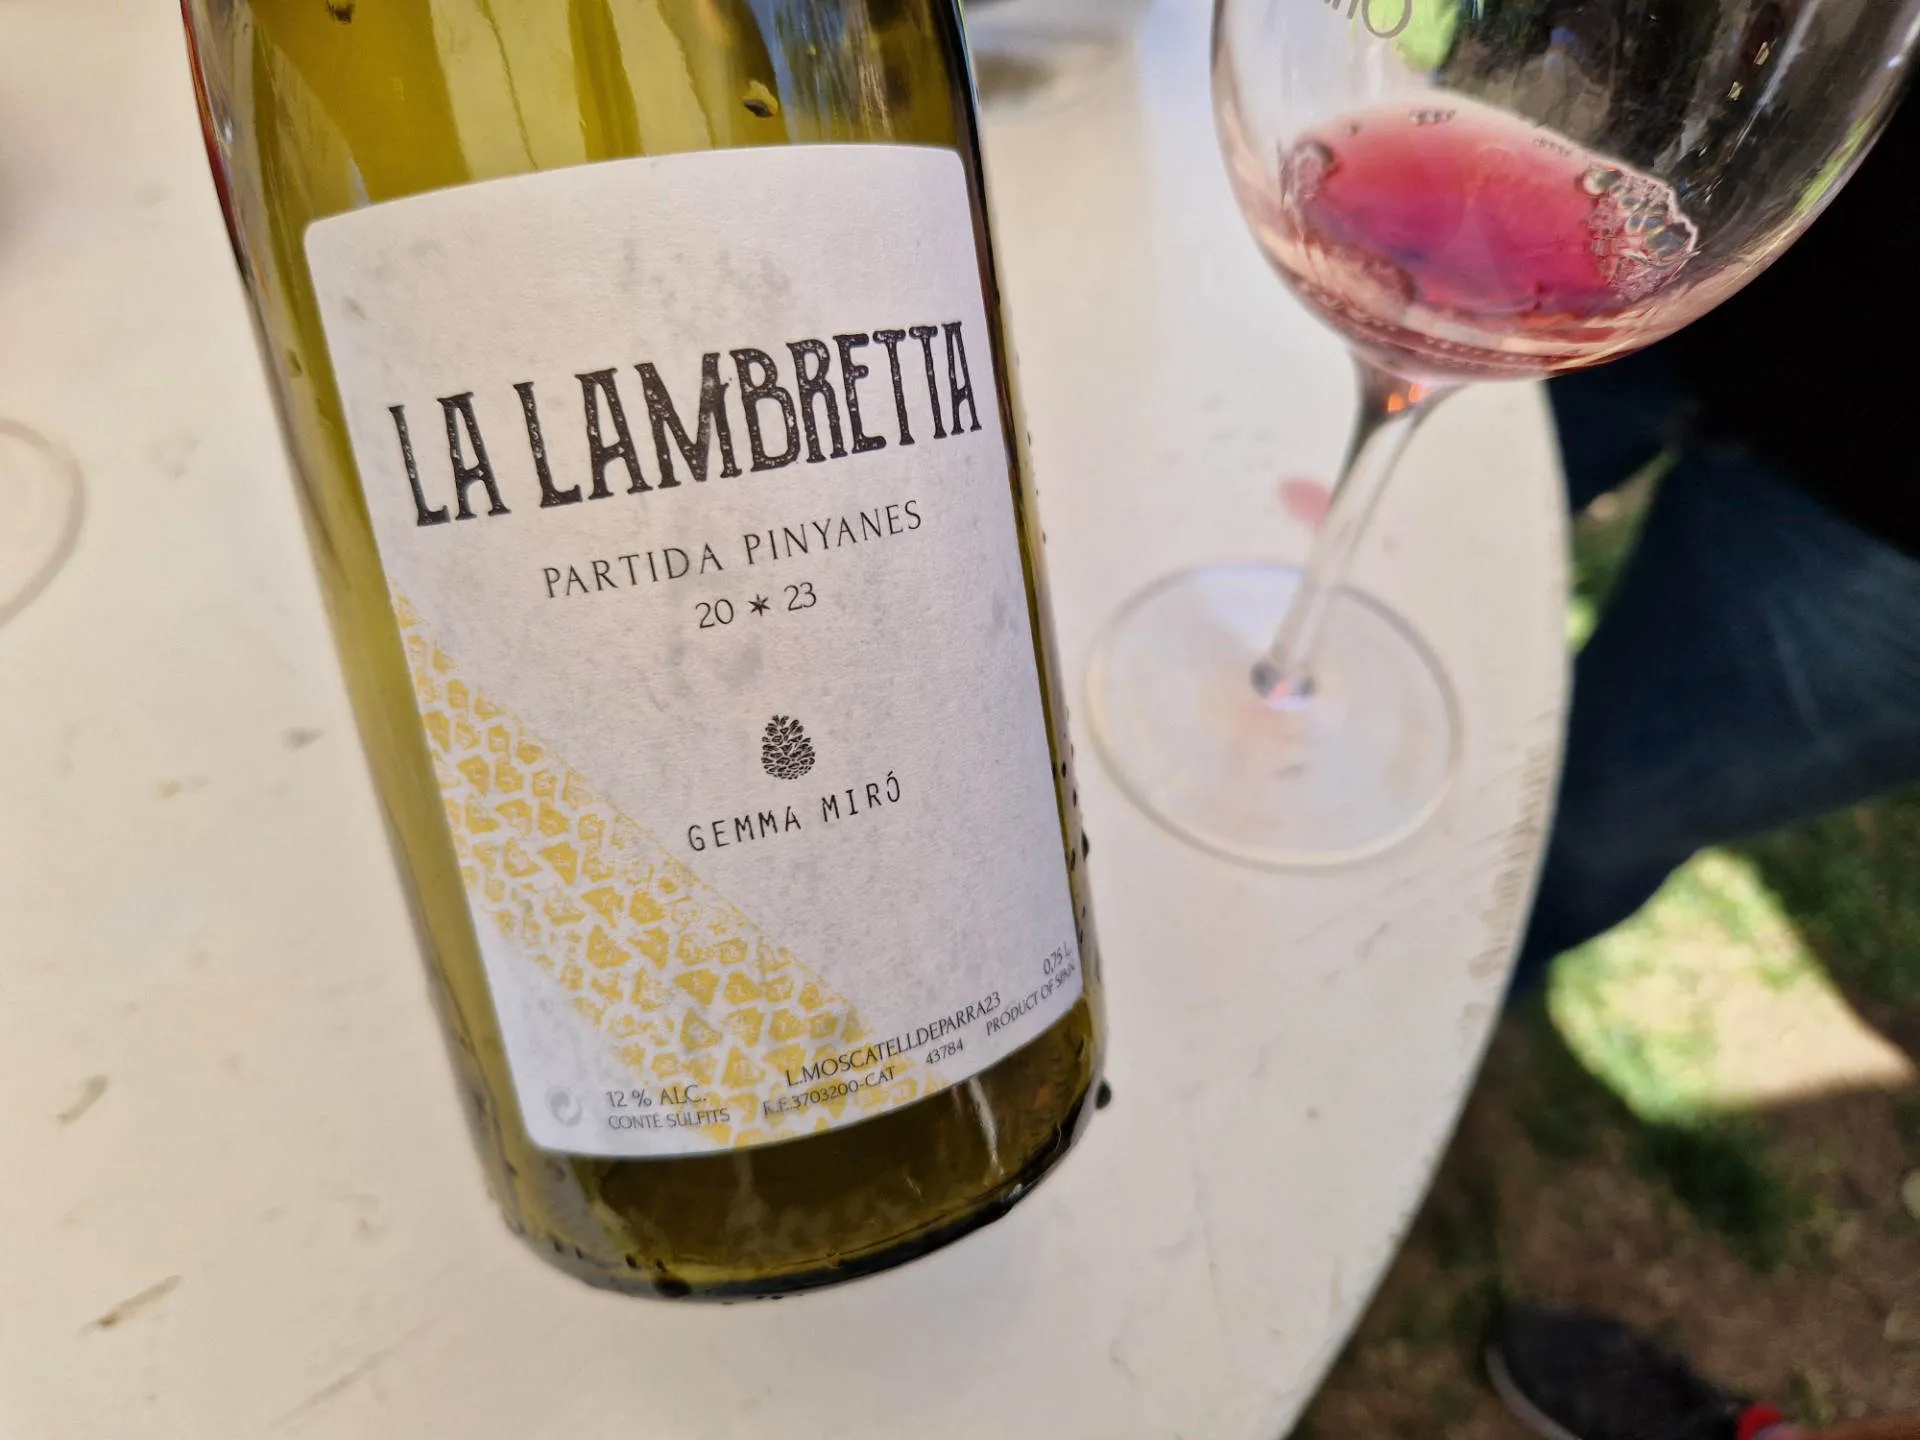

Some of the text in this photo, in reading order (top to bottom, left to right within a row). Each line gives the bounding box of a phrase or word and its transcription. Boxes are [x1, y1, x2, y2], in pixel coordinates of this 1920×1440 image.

[388, 320, 984, 527] LA LAMBRETTA
[543, 500, 922, 599] PARTIDA PINYANES
[695, 581, 817, 628] 20 23
[687, 770, 901, 852] GEMMA MIRÓ
[1042, 941, 1073, 976] 0,75 L
[986, 990, 1039, 1036] PRODUCT
[1040, 978, 1054, 999] OF
[784, 990, 1002, 1087] L.MOSCATELLDEPARRA23
[925, 1037, 965, 1066] 43784
[606, 1084, 708, 1108] 12 % ALC.
[665, 1107, 731, 1128] SULFITS
